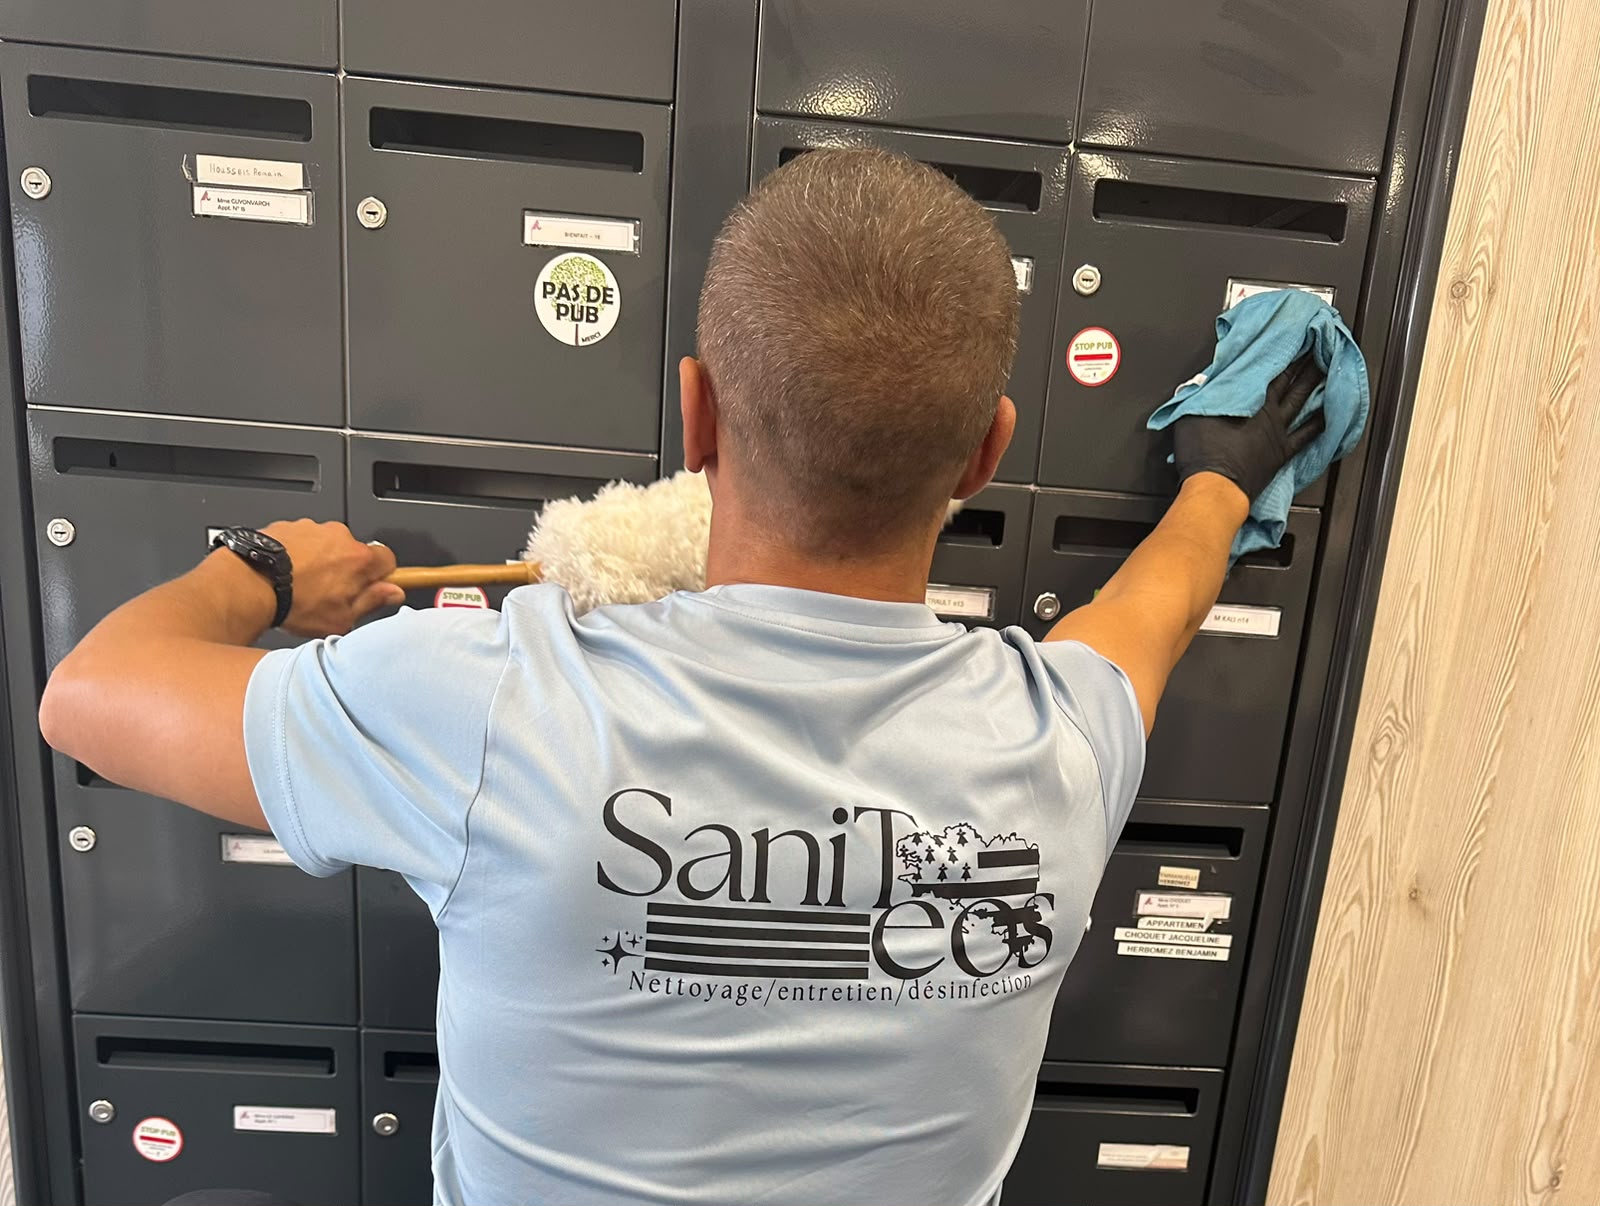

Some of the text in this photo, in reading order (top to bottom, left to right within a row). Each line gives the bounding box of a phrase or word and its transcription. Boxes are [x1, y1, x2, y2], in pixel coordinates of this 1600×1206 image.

[542, 281, 614, 305] PAS DE
[556, 303, 599, 323] PUB
[581, 331, 601, 343] MERCI
[1074, 341, 1113, 351] STOP PUB
[442, 592, 482, 602] STOP PUB
[1146, 919, 1204, 930] APPARTEMEN
[1124, 931, 1220, 944] CHOQUET JACQUELINE
[1126, 945, 1218, 957] HERBOMEZ BENJAMIN
[140, 1126, 176, 1137] STOP PUB
